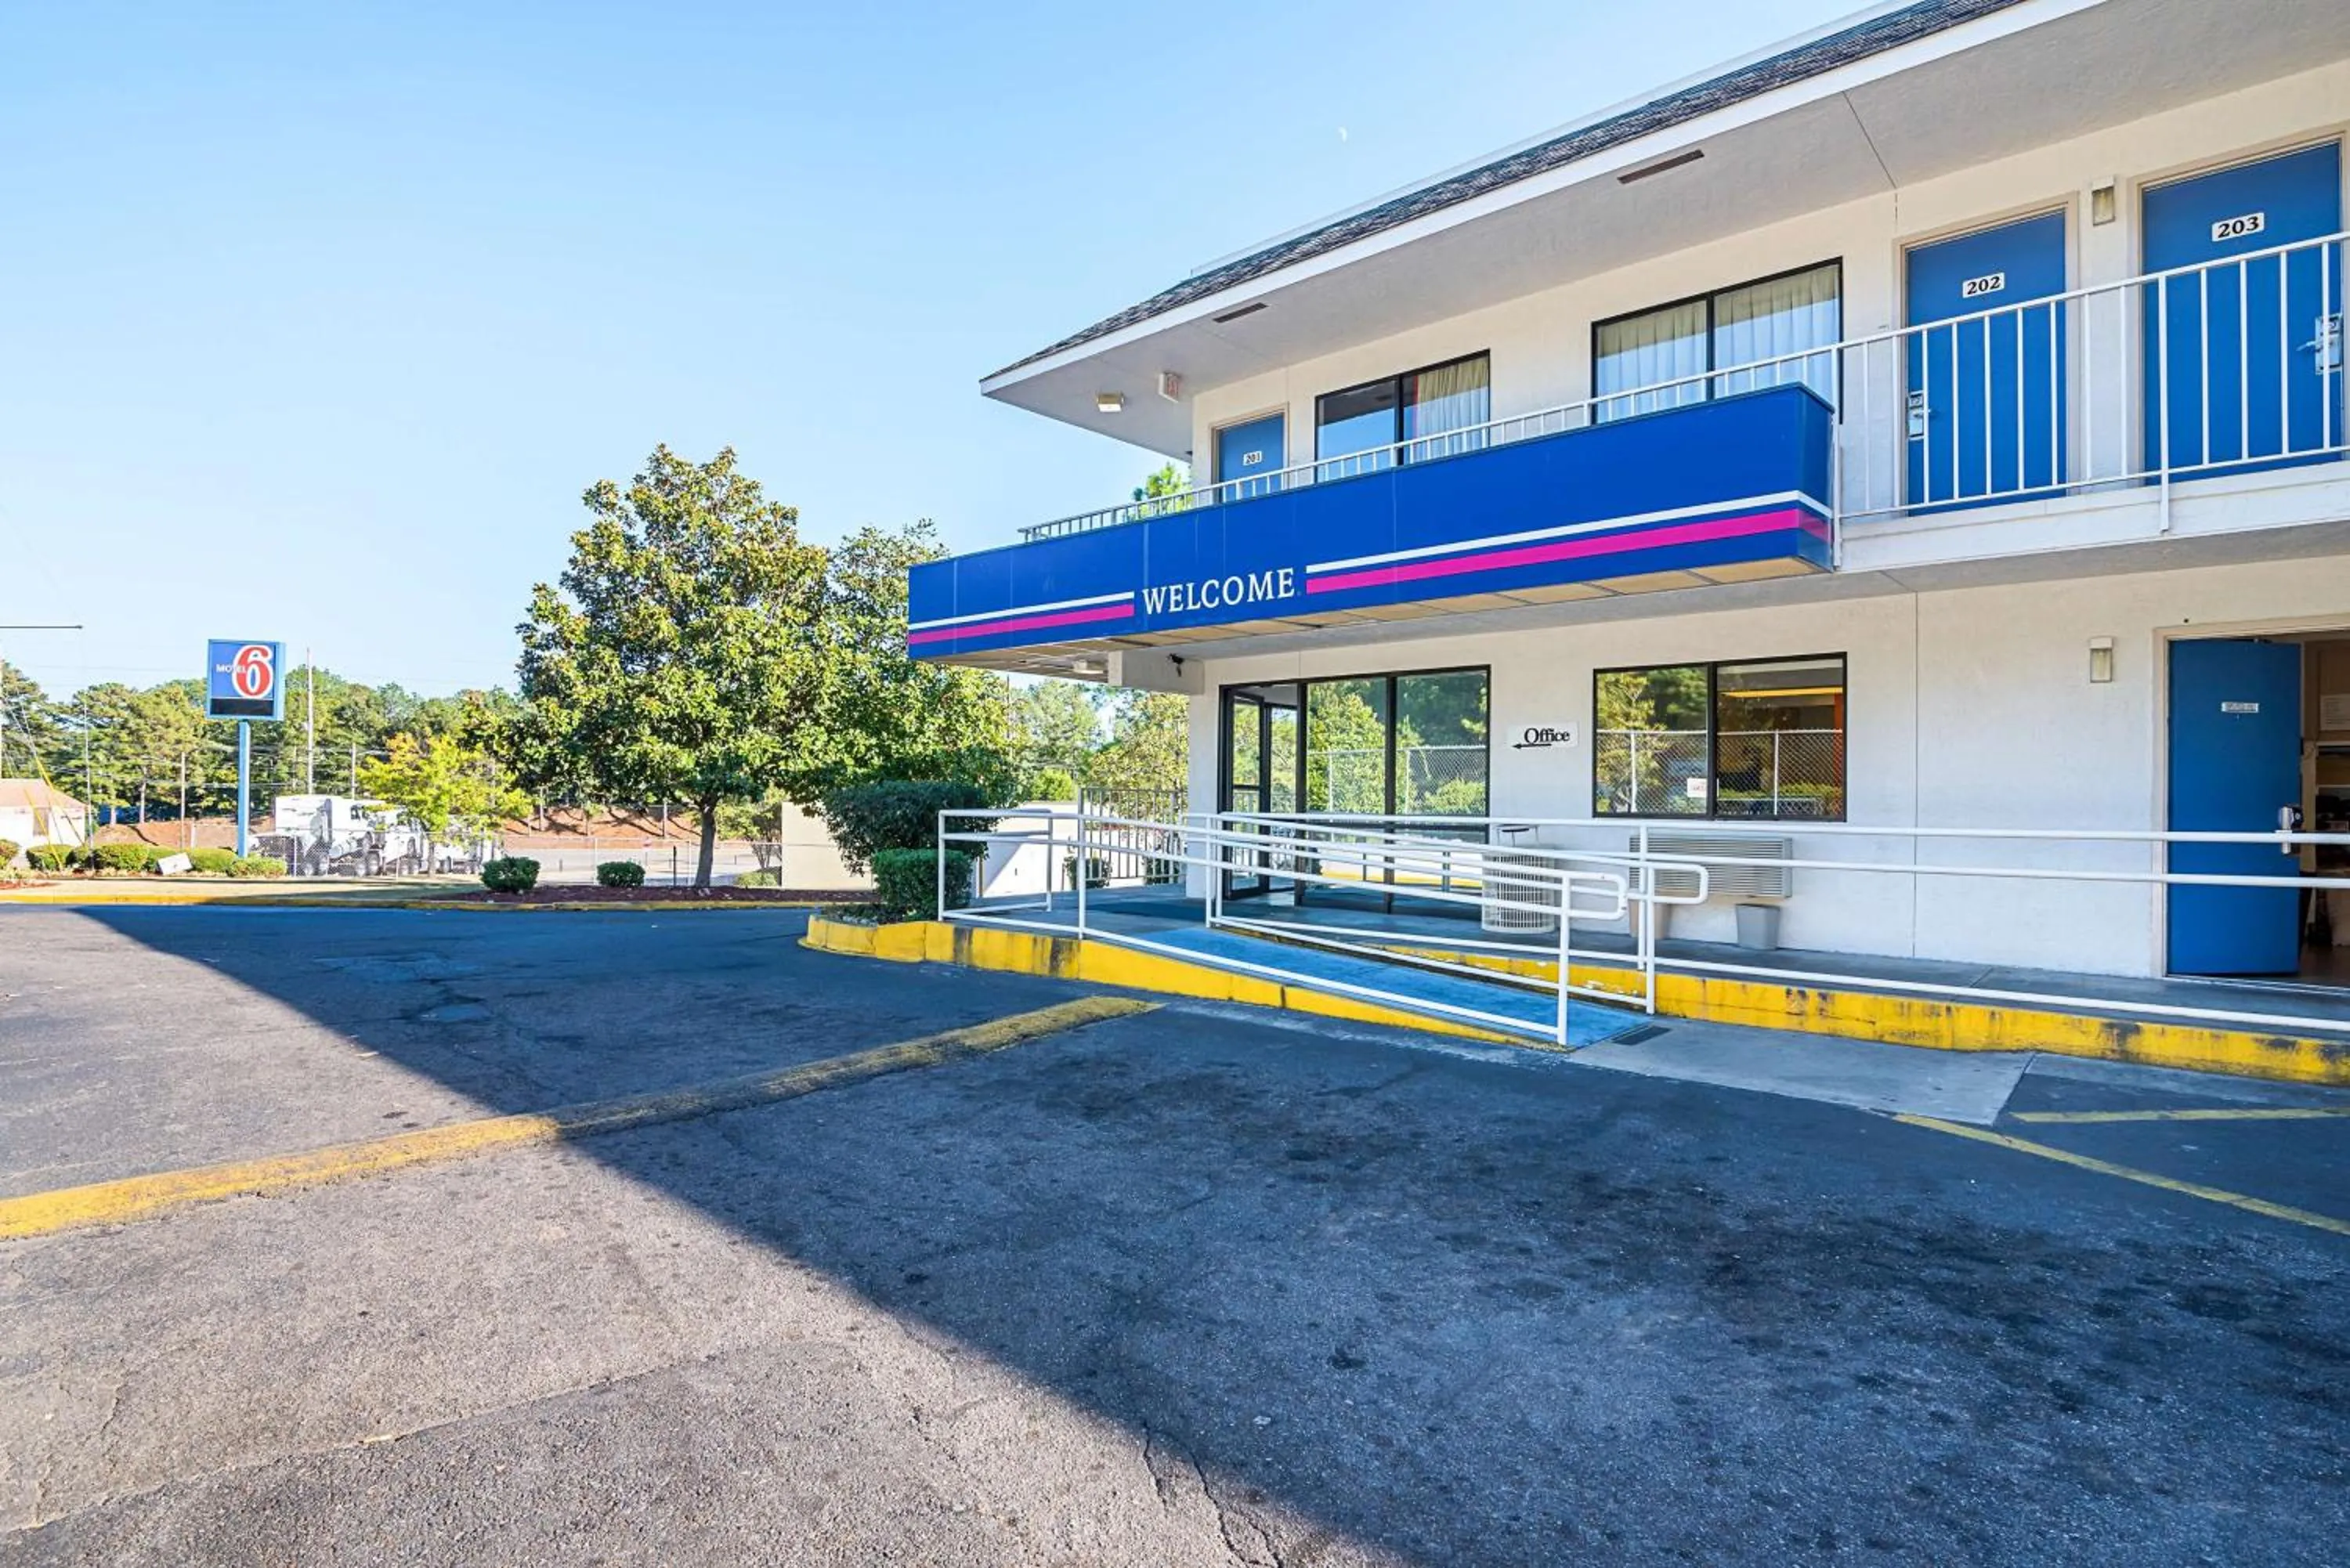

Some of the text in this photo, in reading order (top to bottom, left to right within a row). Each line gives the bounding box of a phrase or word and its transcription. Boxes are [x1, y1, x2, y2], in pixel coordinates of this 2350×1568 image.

[2218, 216, 2259, 238] 203
[1967, 276, 2001, 295] 202
[1142, 567, 1295, 615] WELCOME
[233, 645, 273, 699] 6
[1524, 728, 1570, 744] Office
